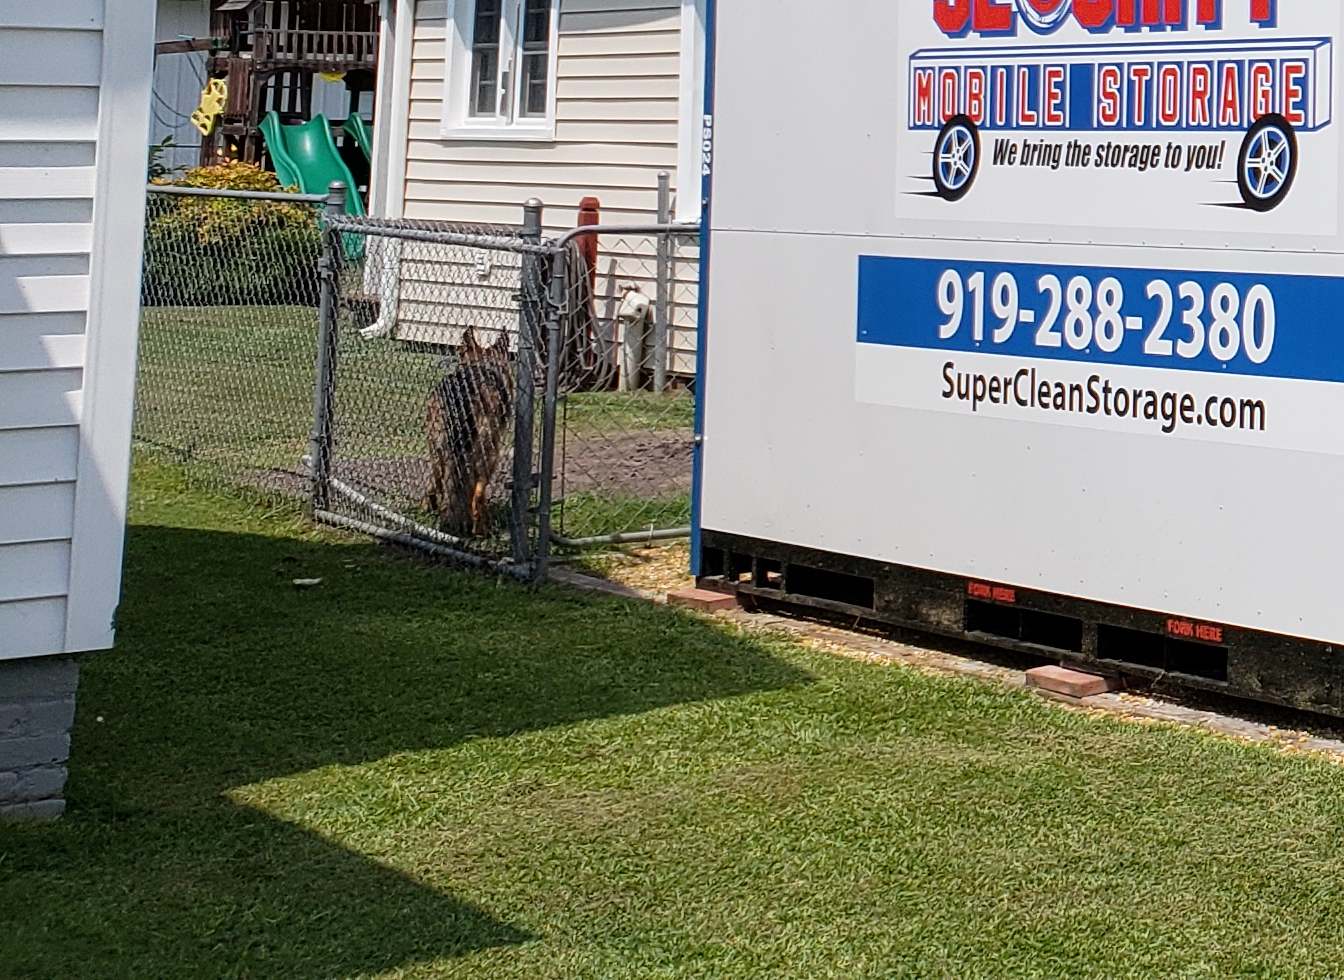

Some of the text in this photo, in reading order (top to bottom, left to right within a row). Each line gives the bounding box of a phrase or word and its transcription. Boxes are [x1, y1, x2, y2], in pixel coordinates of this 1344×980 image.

[915, 62, 1305, 128] MOBILE STORAGE
[702, 114, 712, 176] PS024
[992, 138, 1226, 172] We bring the storage to you!
[937, 269, 1275, 364] 919-288-2380
[941, 361, 1266, 433] SuperCleanStorage.com
[1167, 620, 1222, 642] FORK HERE
